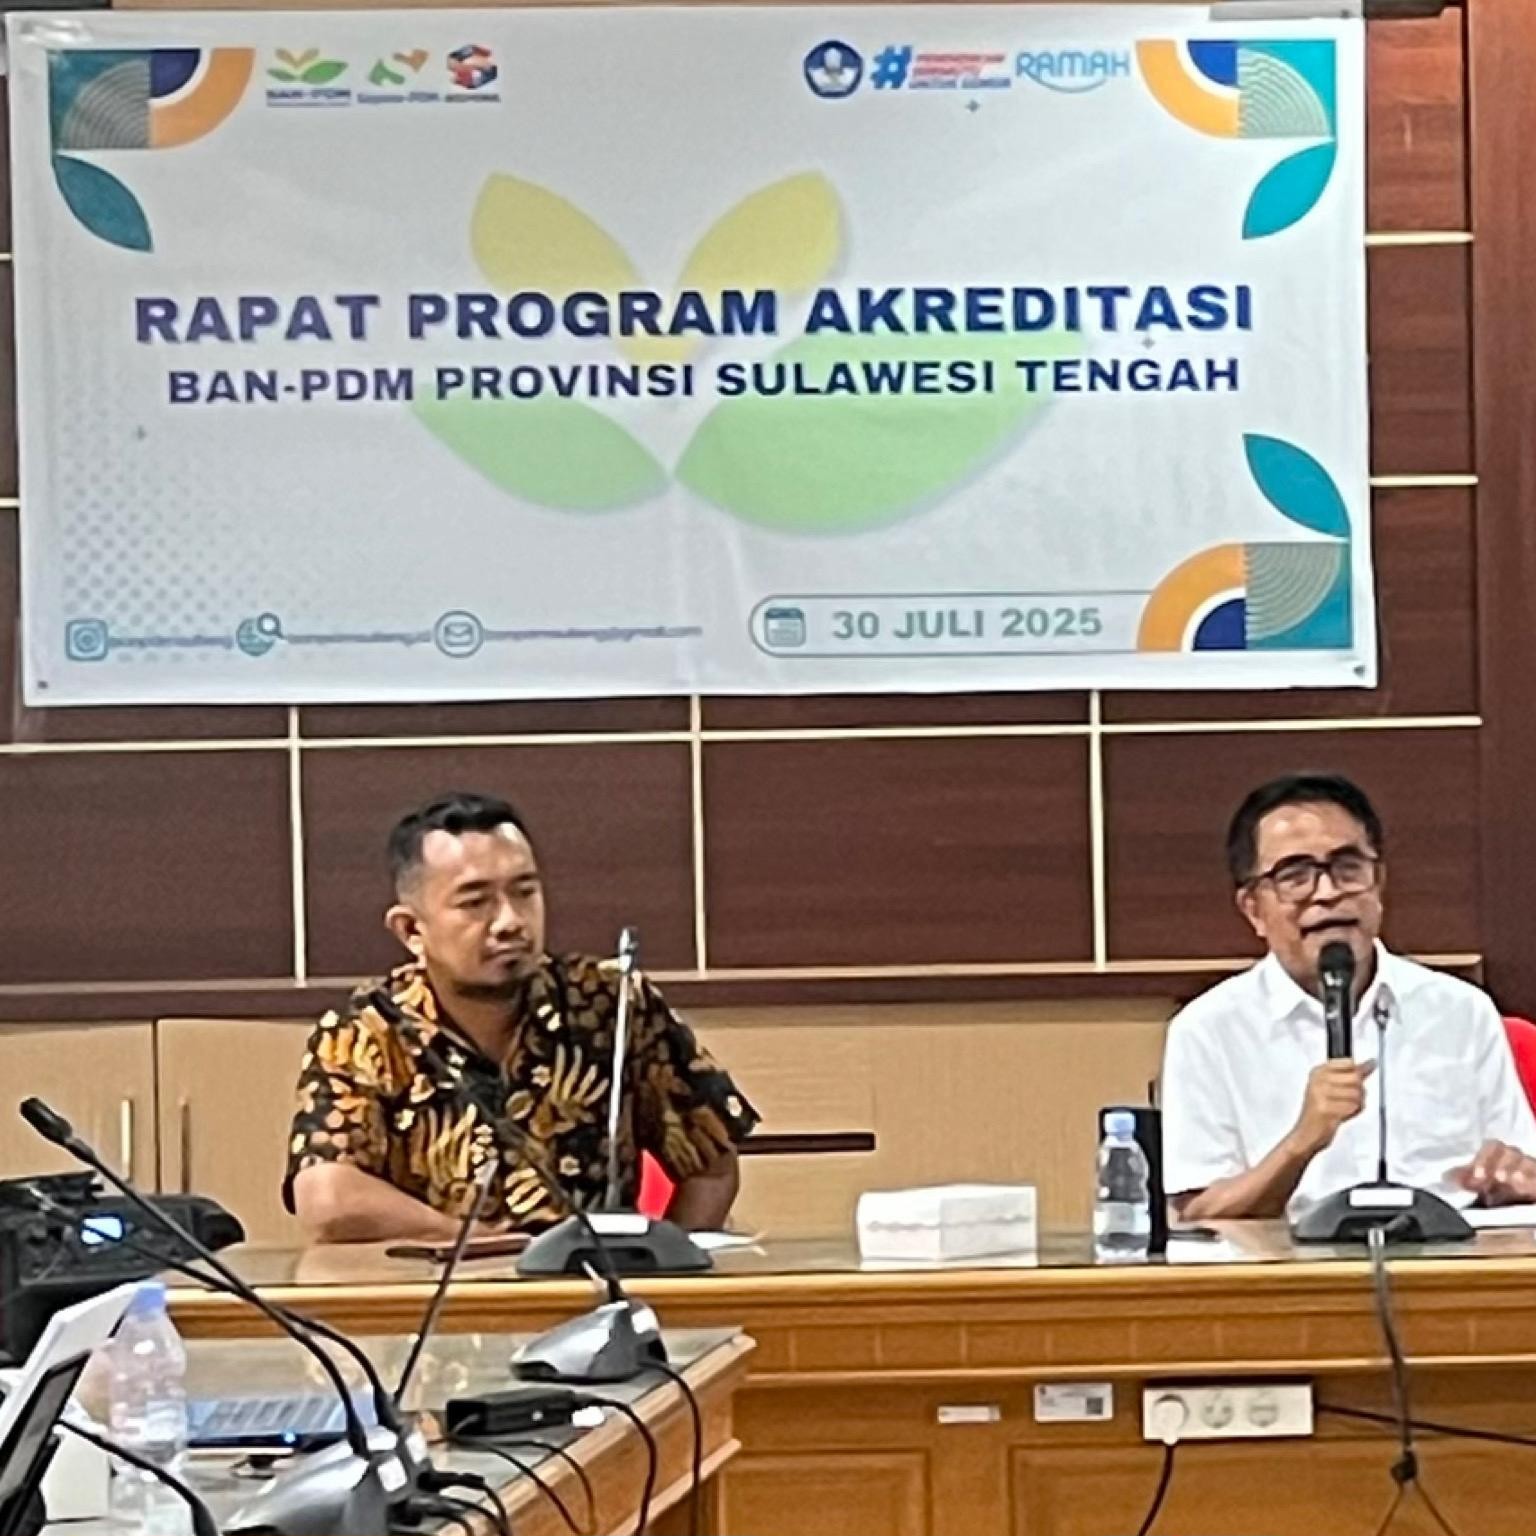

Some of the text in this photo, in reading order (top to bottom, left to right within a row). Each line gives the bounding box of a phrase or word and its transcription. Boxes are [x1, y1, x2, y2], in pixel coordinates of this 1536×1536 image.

[1016, 51, 1131, 77] RAMAH
[135, 285, 1253, 343] RAPAT PROGRAM AKREDITASI
[168, 357, 1239, 404] BAN-PDM PROVINSI SULAWESI TENGAH
[832, 607, 1103, 640] 30 JULI 2025
